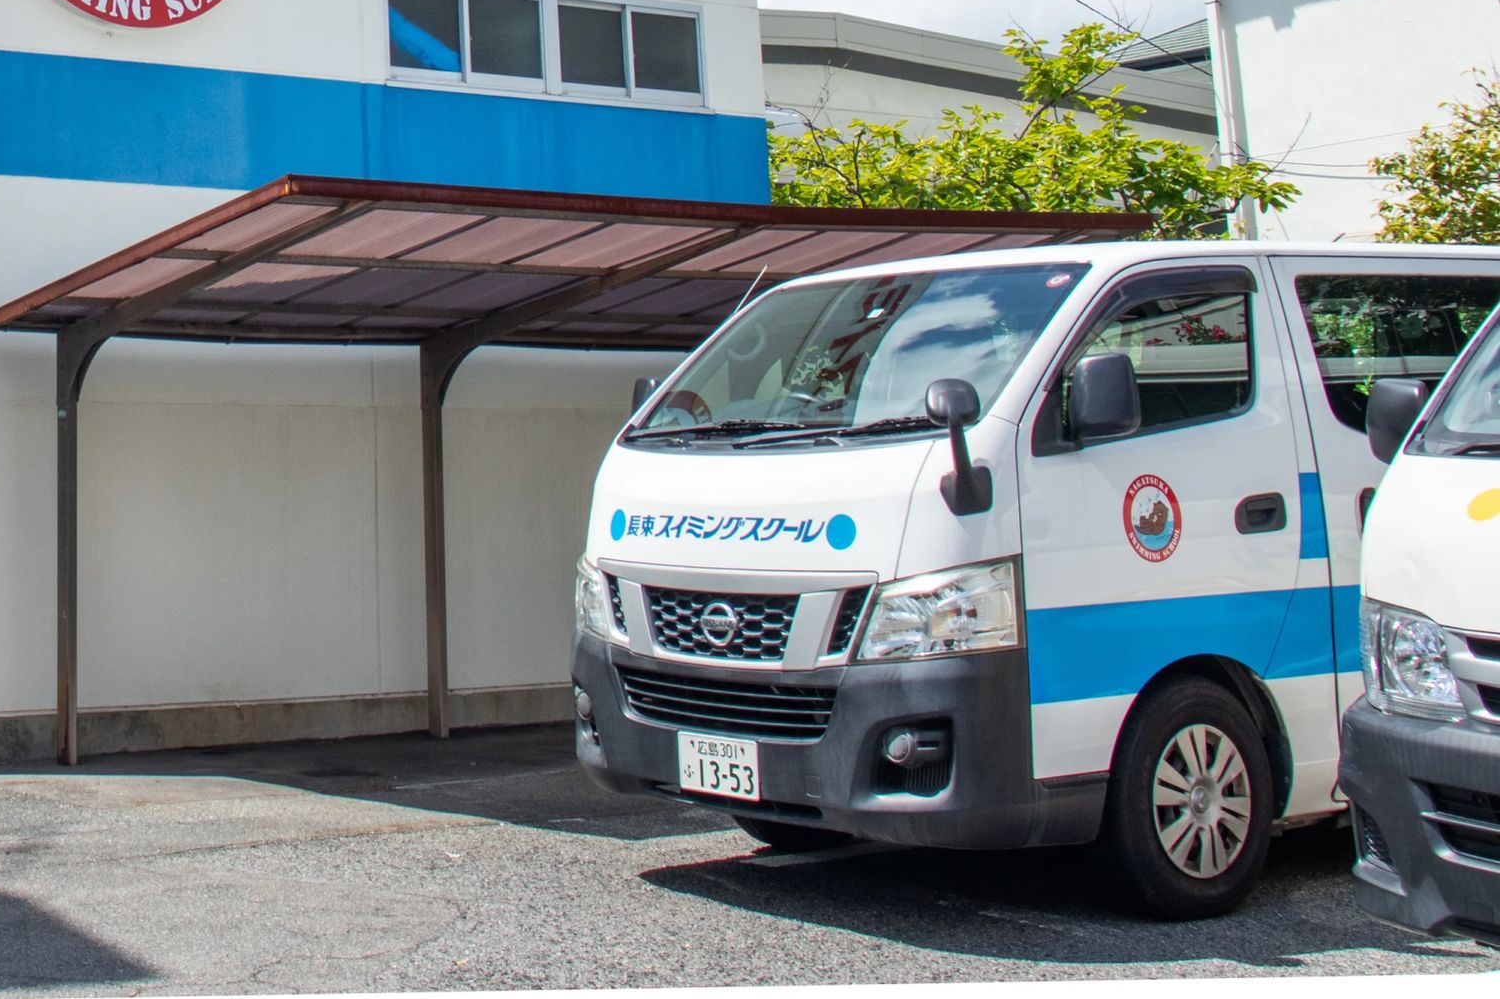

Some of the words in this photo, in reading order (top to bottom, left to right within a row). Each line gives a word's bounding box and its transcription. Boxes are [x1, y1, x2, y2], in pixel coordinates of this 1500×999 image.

[1129, 476, 1169, 496] NAGATSUKA
[627, 515, 825, 543] 長束スイミングスクール
[1129, 532, 1161, 560] SWIMMING
[1163, 529, 1180, 558] SCHOOL
[702, 617, 733, 628] NISSAN
[684, 763, 694, 778] ふ
[699, 759, 754, 794] 13-53
